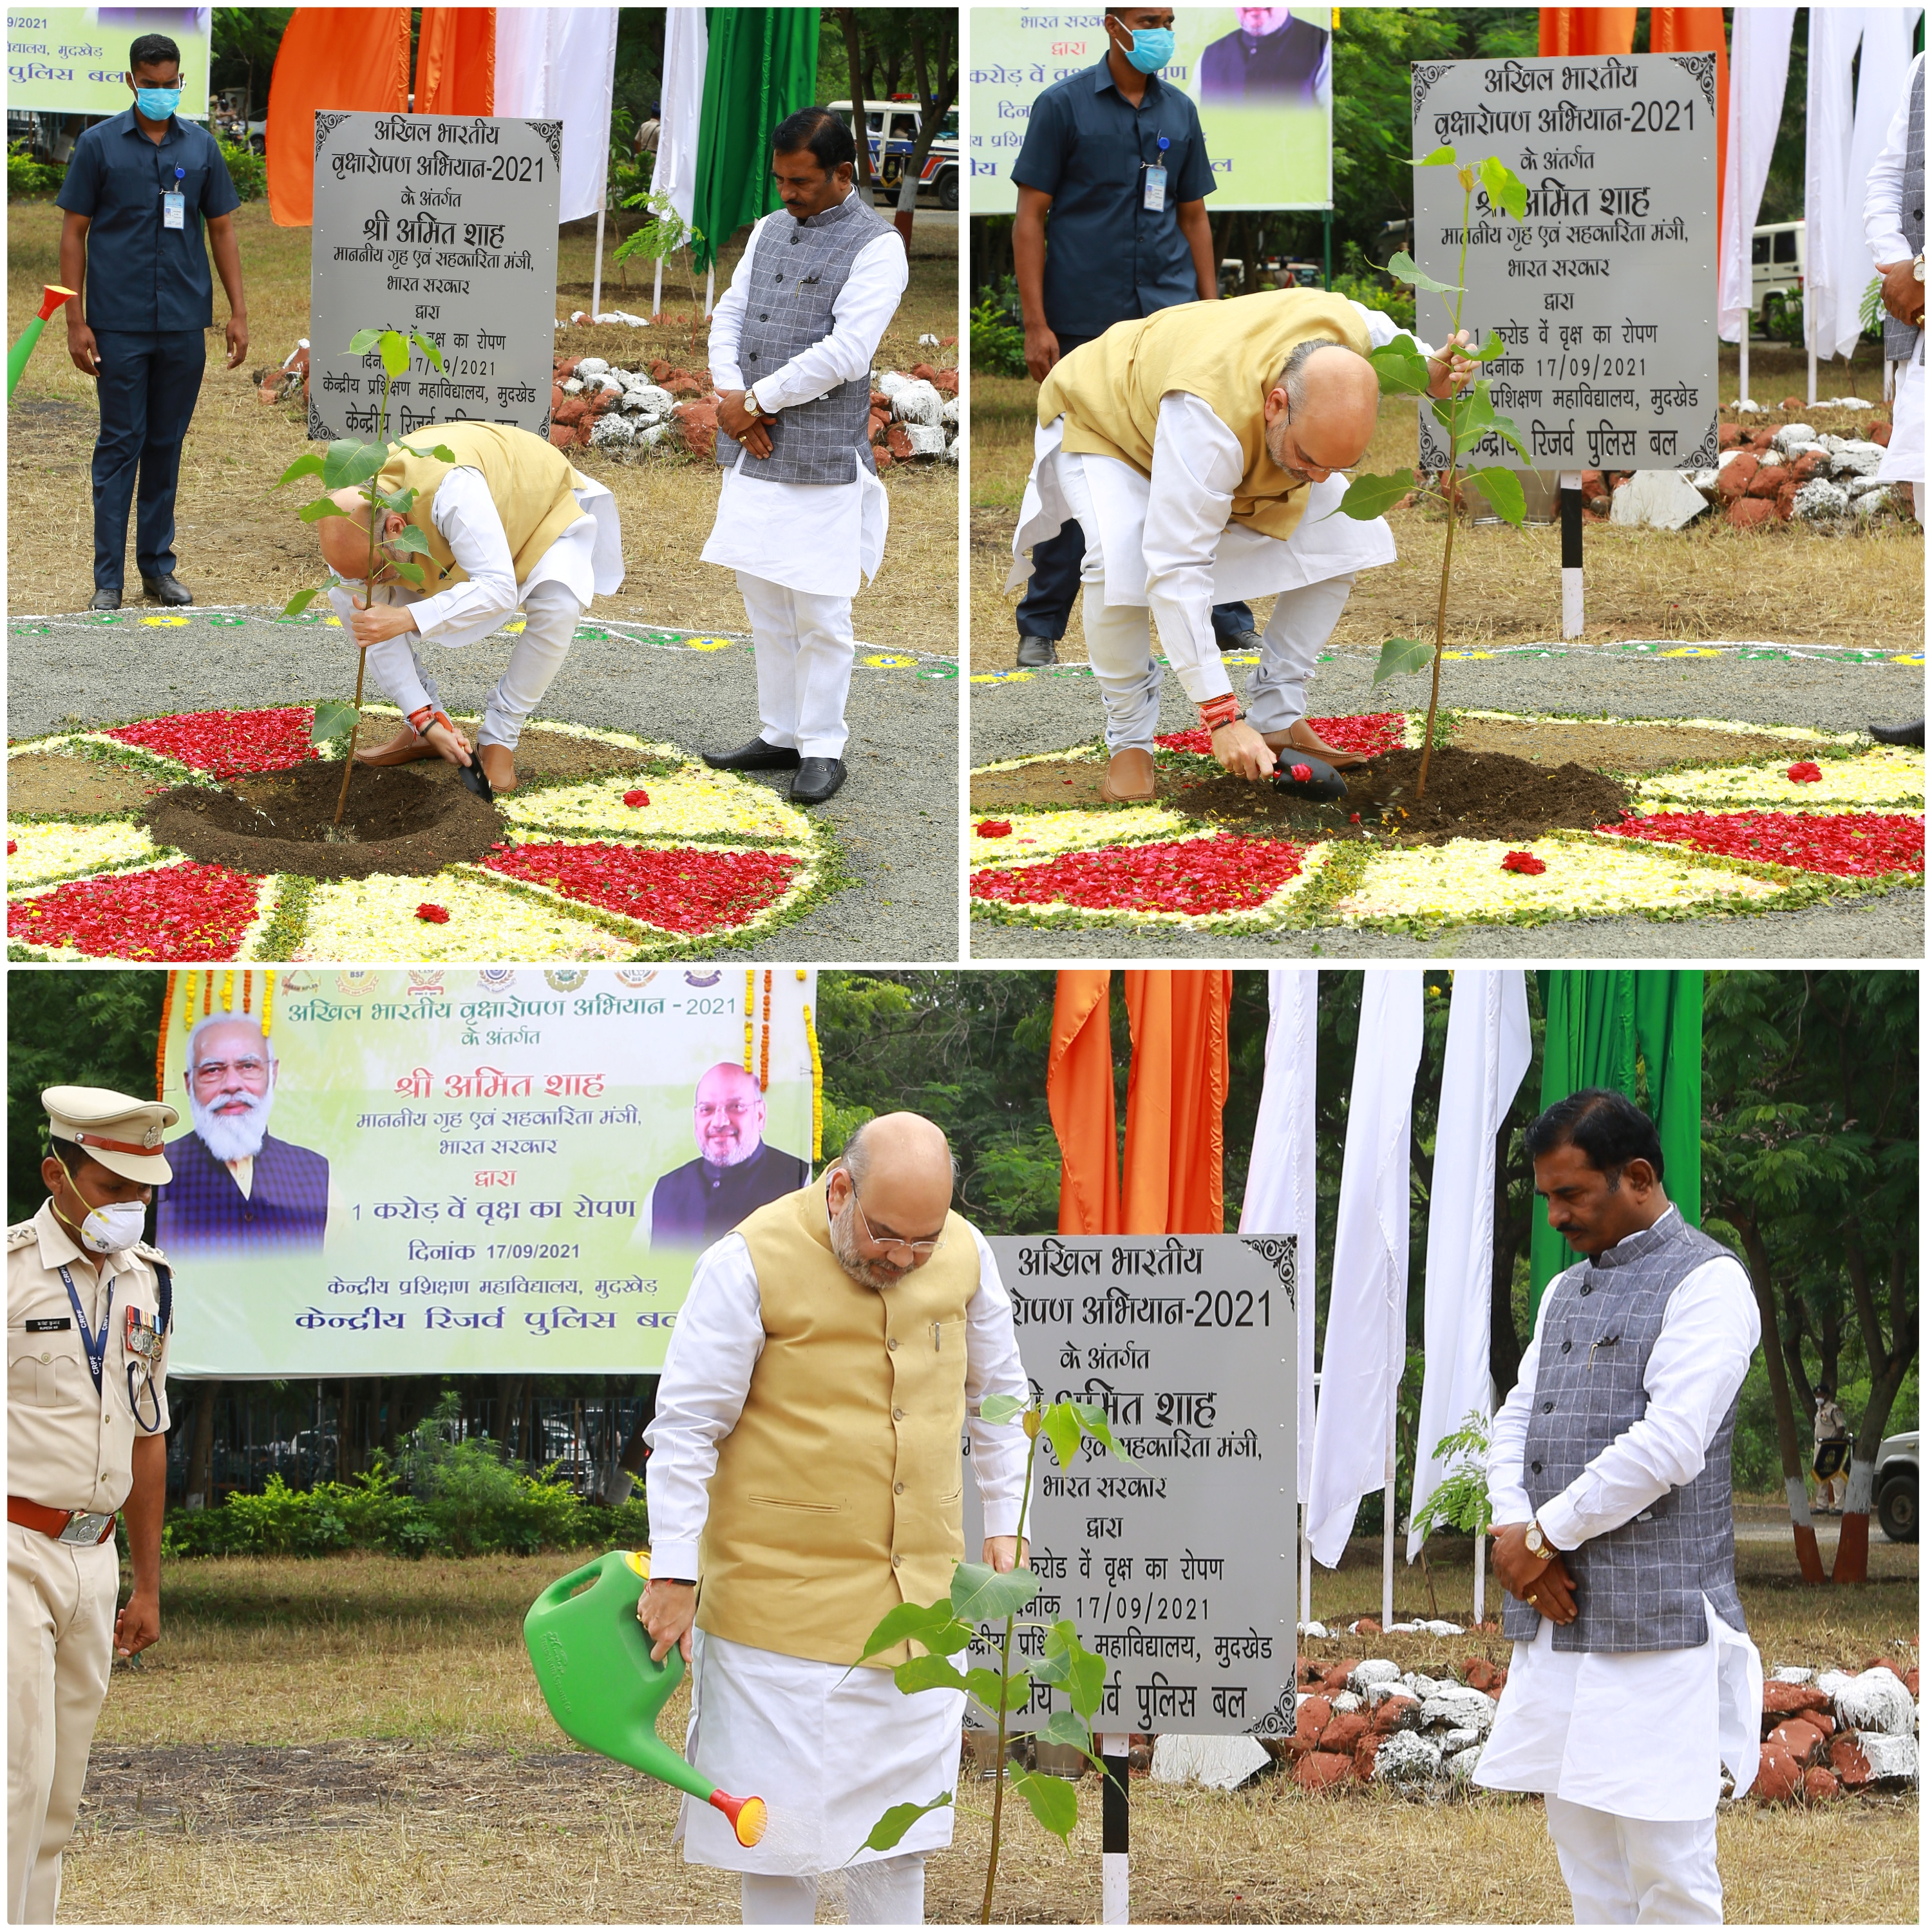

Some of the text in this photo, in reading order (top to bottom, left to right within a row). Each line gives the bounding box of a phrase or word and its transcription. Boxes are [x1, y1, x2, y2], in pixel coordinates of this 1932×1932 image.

[1021, 15, 1059, 28] भारत
[59, 43, 103, 59] मुदखेड़
[1052, 41, 1086, 55] द्वारा
[8, 62, 126, 83] पुलिस बल
[970, 63, 1023, 87] करोड़
[1029, 62, 1045, 82] वें
[1484, 57, 1638, 93] अखिल भारतीय
[375, 115, 500, 145] अखिल भारतीय
[1434, 99, 1694, 145] वृक्षारोपण अभियान-2021
[332, 147, 544, 182] वृक्षारोपण अभियान-2021
[1520, 145, 1595, 171] के अंतर्गत
[401, 185, 462, 207] के अंतर्गत
[1523, 177, 1591, 218] अमित
[1598, 186, 1651, 218] शाह
[363, 209, 506, 249] श्री अमित शाह
[1441, 221, 1502, 245] माननीय
[1507, 226, 1532, 251] गृह
[1537, 221, 1562, 248] एवं
[1566, 218, 1646, 243] सहकारिता
[334, 243, 384, 262] माननीय
[387, 249, 408, 269] गृह
[413, 248, 431, 269] एवं
[435, 248, 500, 269] सहकारिता
[1508, 258, 1610, 278] भारत सरकार
[388, 276, 470, 295] भारत सरकार
[415, 305, 440, 319] द्वारा
[1544, 292, 1575, 310] द्वारा
[453, 334, 469, 348] का
[477, 328, 506, 350] रोपण
[1539, 319, 1549, 344] वें
[1559, 325, 1583, 351] वृक्ष
[1592, 325, 1612, 344] का
[1622, 317, 1658, 344] रोपण
[1537, 354, 1645, 381] 17/09/2021
[323, 371, 536, 408] केन्द्रीय प्रशिक्षण महाविद्यालय, मुदखेड
[1490, 382, 1542, 408] प्रशिक्षण
[1552, 383, 1640, 411] महाविद्यालय,
[1650, 381, 1698, 415] मुदखेड
[345, 402, 390, 434] केन्द्रीय
[1531, 419, 1575, 456] रिजर्व
[1587, 419, 1637, 467] पुलिस
[1649, 429, 1678, 456] बल
[289, 998, 363, 1023] अखिल
[371, 997, 454, 1021] भारतीय
[459, 994, 568, 1025] वृक्षारोपण
[573, 992, 666, 1017] अभियान
[687, 998, 736, 1015] 2021
[461, 1026, 541, 1045] के अंतर्गत
[393, 1066, 605, 1099] श्री अमित शाह
[356, 1107, 428, 1129] माननीय
[433, 1111, 462, 1132] गृह
[469, 1106, 497, 1130] एवं
[501, 1104, 594, 1128] सहकारिता
[440, 1139, 559, 1155] भारत सरकार
[474, 1171, 516, 1187] द्वारा
[352, 1194, 636, 1226] 1 करोड़ वें वृक्ष का रोपण
[408, 1238, 580, 1262] दिनांक 17/09/2021
[1018, 1237, 1204, 1277] अखिल भारतीय
[327, 1274, 658, 1299] केन्द्रीय प्रशिक्षण महाविद्यालय, मुदखेड़
[77, 1309, 86, 1329] CRPF
[294, 1306, 406, 1331] केन्द्रीय
[424, 1305, 507, 1330] रिजर्व
[524, 1305, 617, 1336] पुलिस
[1082, 1287, 1270, 1327] अभियान-2021
[90, 1356, 99, 1374] CRPF
[1059, 1340, 1150, 1370] के अंतर्गत
[1155, 1392, 1217, 1428] शाह
[1043, 1476, 1167, 1499] भारत सरकार
[1086, 1517, 1124, 1539] द्वारा
[1079, 1547, 1092, 1578] वें
[1104, 1557, 1133, 1587] वृक्ष
[1145, 1558, 1168, 1579] का
[1180, 1549, 1224, 1580] रोपण
[1077, 1591, 1208, 1624] 17/09/2021
[1095, 1626, 1201, 1663] महाविद्यालय,
[1214, 1627, 1273, 1668] मुदखेड
[1136, 1672, 1197, 1730] पुलिस
[1211, 1686, 1247, 1718] बल
